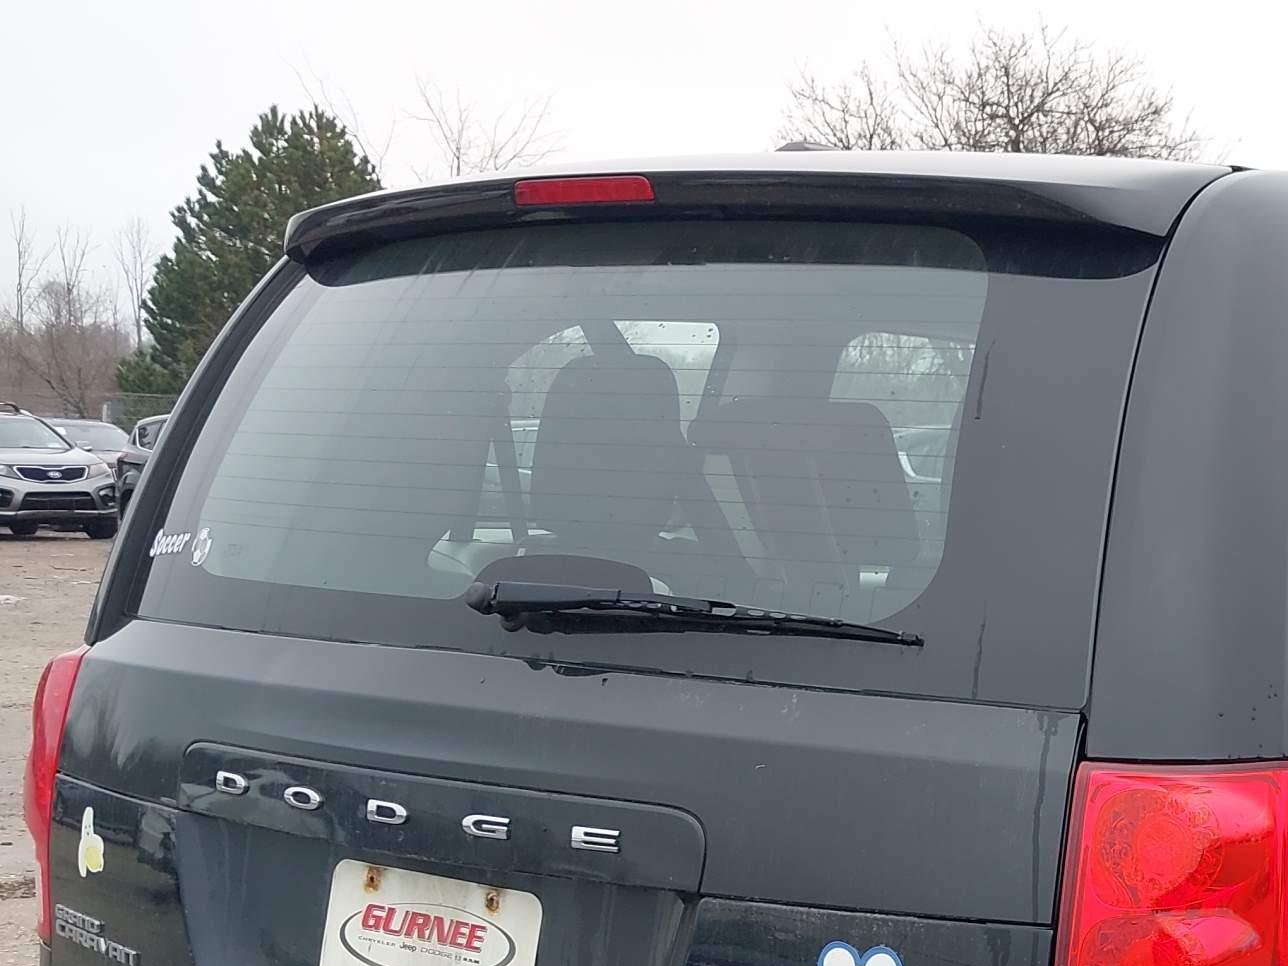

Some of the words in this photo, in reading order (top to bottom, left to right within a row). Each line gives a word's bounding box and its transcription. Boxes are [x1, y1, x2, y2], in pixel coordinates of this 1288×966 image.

[149, 528, 191, 557] Soccer
[215, 769, 621, 853] DODGE
[361, 903, 487, 953] GURNEE
[399, 941, 417, 952] Jeep
